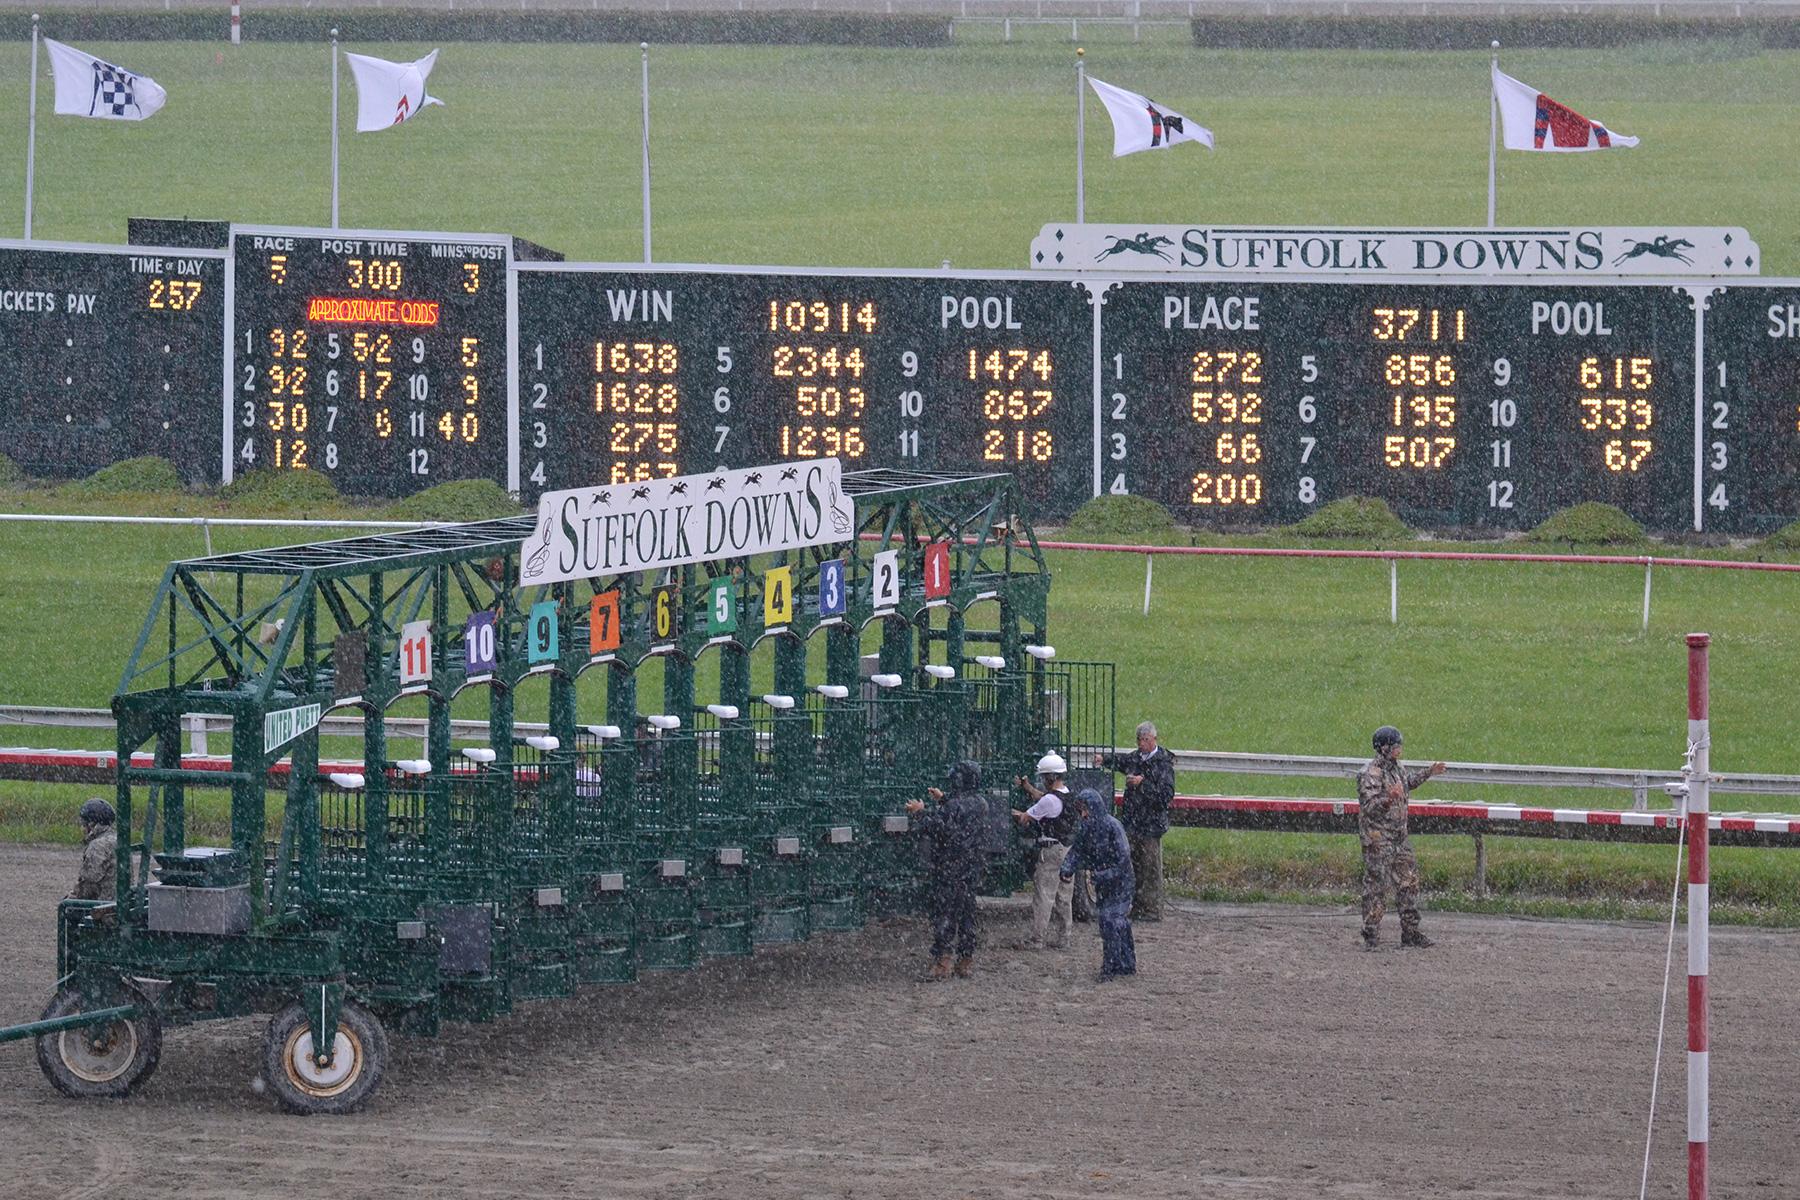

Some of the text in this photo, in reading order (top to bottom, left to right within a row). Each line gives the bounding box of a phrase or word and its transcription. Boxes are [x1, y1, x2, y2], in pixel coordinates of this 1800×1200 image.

[255, 237, 293, 251] RACE
[322, 241, 407, 256] POST TIME
[472, 246, 503, 260] POST
[1181, 229, 1603, 270] SUFFOLK DOWNS
[129, 257, 163, 274] TIME
[178, 260, 204, 276] DAY
[348, 260, 401, 290] 300
[464, 264, 478, 292] 3
[68, 294, 96, 314] PAY
[149, 280, 202, 310] 257
[607, 290, 672, 321] WIN
[309, 299, 439, 324] APPROXIMATE ODDS
[771, 301, 876, 332] 10914
[942, 296, 1021, 329] POOL
[1165, 297, 1259, 330] PLACE
[1374, 309, 1463, 340] 3711
[1533, 301, 1611, 335] POOL
[246, 329, 251, 353] 1
[328, 333, 340, 359] 5
[412, 338, 424, 363] 9
[462, 338, 477, 367] 5
[535, 344, 542, 370] 1
[596, 343, 676, 373] 1638
[717, 347, 732, 372] 5
[774, 346, 864, 377] 2344
[902, 351, 918, 376] 9
[969, 350, 1052, 380] 1474
[1114, 353, 1122, 379] 1
[1193, 352, 1260, 383] 272
[1302, 356, 1317, 382] 5
[1386, 355, 1455, 386] 856
[245, 365, 255, 390] 2
[327, 370, 338, 396] 6
[1494, 358, 1510, 386] 9
[1581, 358, 1651, 389] 615
[1718, 362, 1725, 387] 1
[409, 375, 428, 400] 10
[463, 376, 477, 404] 9
[533, 384, 547, 408] 2
[596, 383, 676, 413] 1628
[714, 387, 730, 412] 6
[243, 402, 255, 426] 3
[269, 402, 307, 431] 30
[899, 391, 922, 417] 10
[1112, 393, 1126, 419] 2
[1193, 392, 1261, 423] 592
[1299, 396, 1316, 422] 6
[1395, 396, 1454, 427] 195
[1489, 400, 1516, 427] 10
[1581, 399, 1651, 430] 339
[1713, 402, 1728, 428] 2
[327, 407, 337, 431] 7
[410, 412, 424, 436] 11
[439, 412, 477, 442] 40
[534, 422, 547, 448] 3
[611, 423, 676, 452] 275
[715, 426, 730, 452] 7
[783, 426, 864, 457] 1296
[899, 430, 918, 456] 11
[985, 430, 1051, 460] 218
[1111, 433, 1126, 460] 3
[1217, 433, 1260, 463] 66
[242, 438, 255, 463] 4
[276, 439, 306, 468] 12
[326, 443, 338, 469] 8
[409, 449, 428, 474] 12
[1301, 437, 1316, 463] 7
[1385, 437, 1454, 467] 507
[1491, 440, 1510, 467] 11
[1605, 440, 1651, 471] 67
[1711, 442, 1727, 470] 3
[531, 462, 546, 485] 4
[1110, 474, 1128, 495] 4
[1192, 473, 1260, 504] 200
[1299, 477, 1315, 503] 8
[1488, 481, 1513, 507] 12
[1710, 484, 1728, 510] 4
[559, 466, 822, 574] SUFFOLK DOWNS
[880, 564, 892, 598] 2
[931, 553, 940, 588] 1
[772, 580, 784, 614] 4
[826, 566, 838, 609] 3
[656, 590, 670, 636] 6
[715, 587, 728, 622] 5
[537, 616, 550, 652] 9
[599, 605, 611, 641] 7
[403, 636, 427, 676] 11
[466, 623, 494, 664] 10
[266, 711, 292, 751] UNITED
